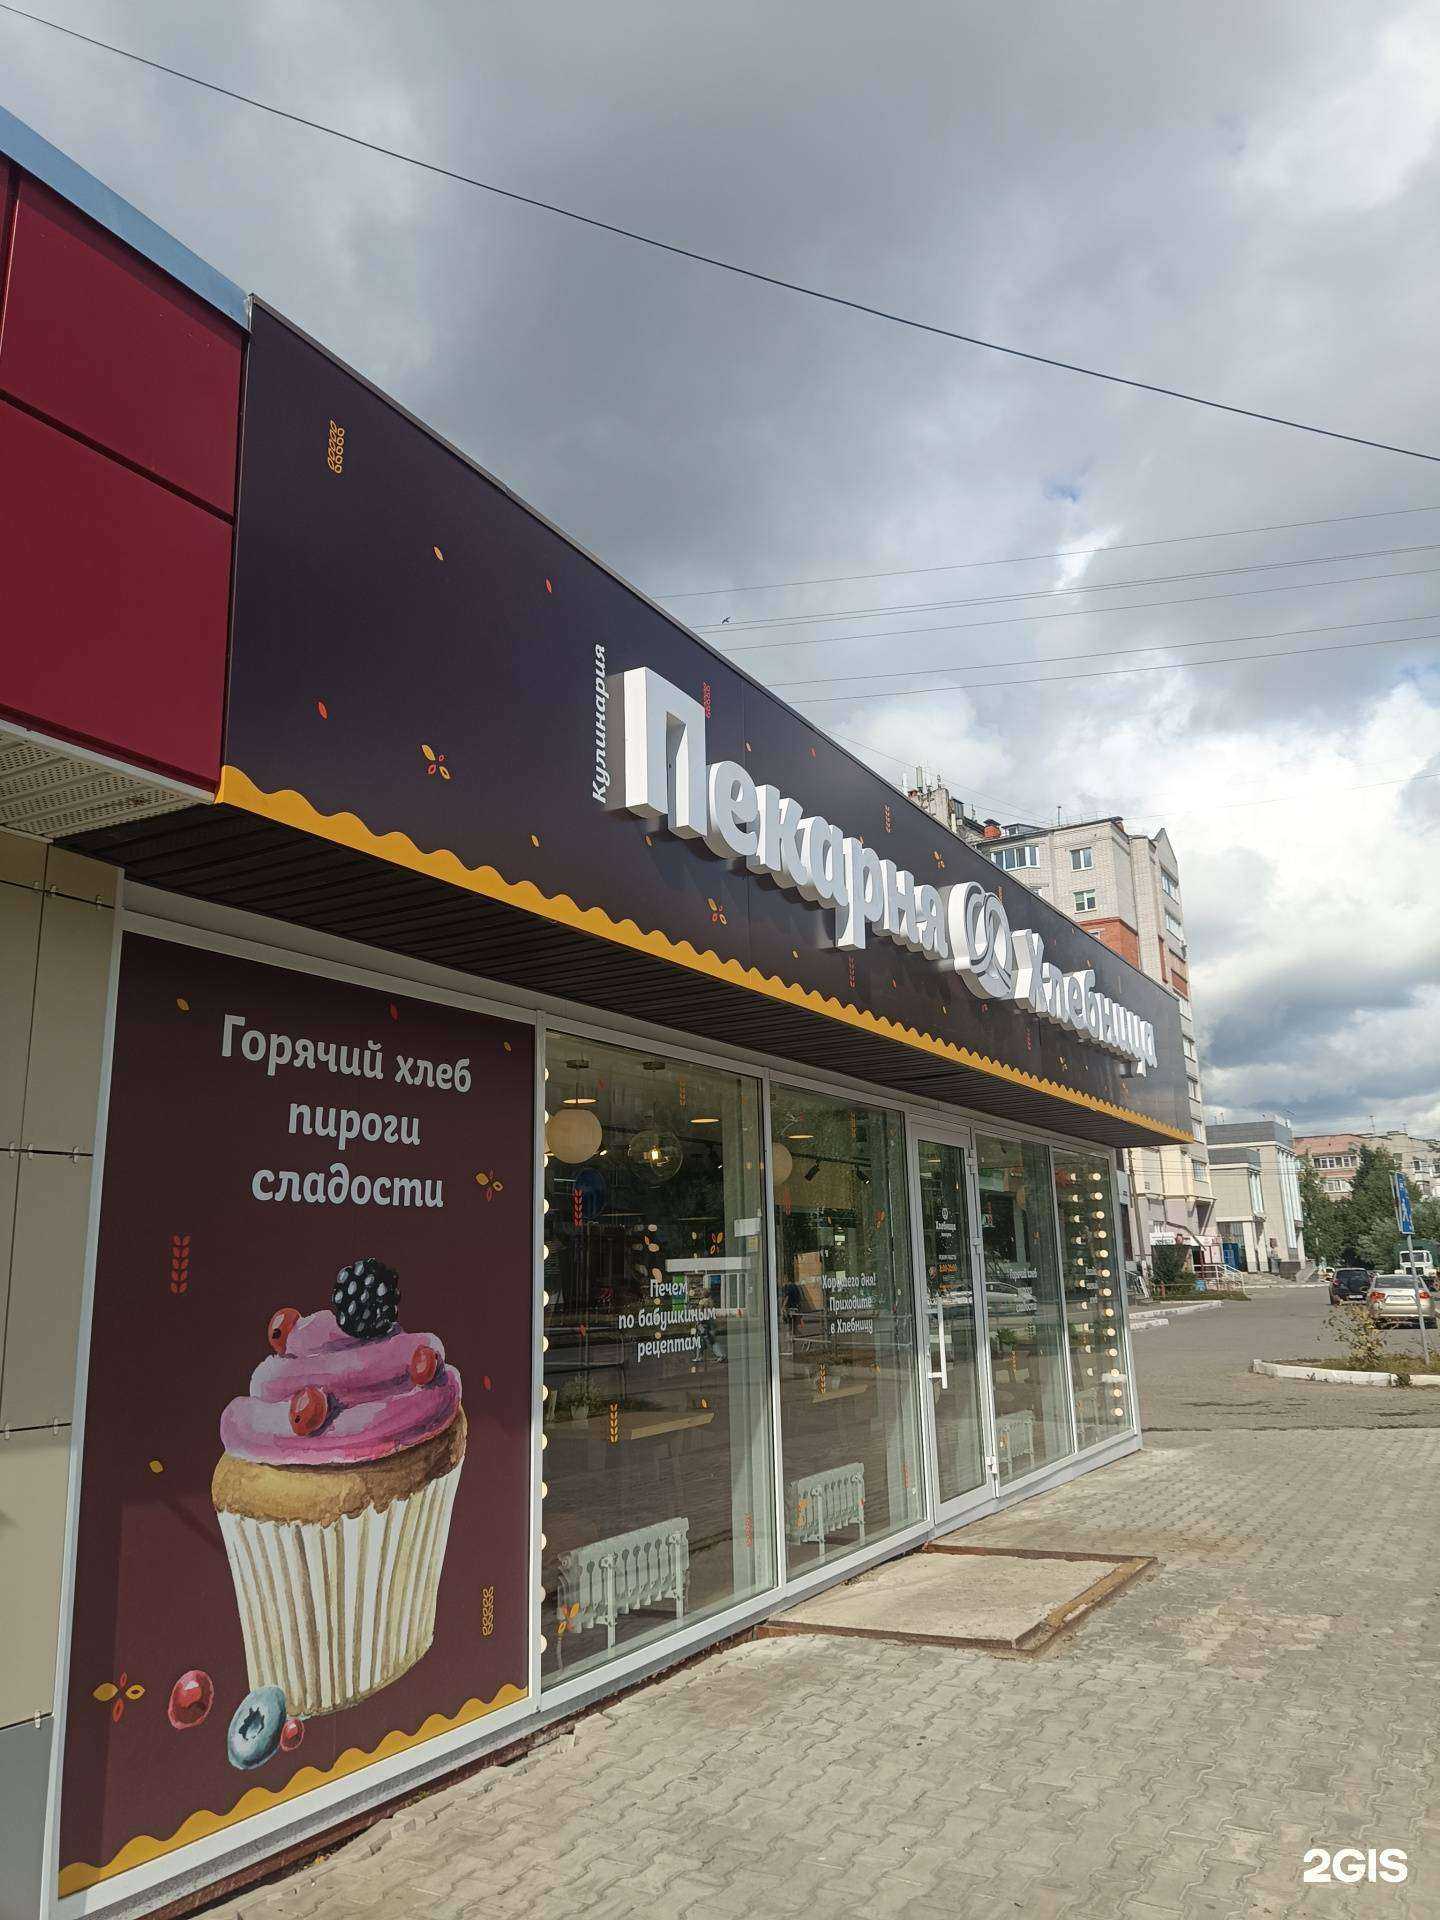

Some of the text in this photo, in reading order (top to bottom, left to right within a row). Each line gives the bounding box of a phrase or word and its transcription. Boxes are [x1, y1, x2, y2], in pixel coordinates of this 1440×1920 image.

[592, 644, 611, 804] Кулинария
[624, 666, 1158, 1078] Пекарня Хлебница
[221, 1013, 472, 1093] Горячий хлеб
[288, 1102, 421, 1150] пироги
[251, 1162, 444, 1208] сладости
[650, 1278, 688, 1297] Печем
[829, 1295, 872, 1315] Приходите
[618, 1307, 717, 1331] по бабушкиным
[830, 1317, 873, 1335] в Хлебницу
[637, 1335, 702, 1363] рецептам
